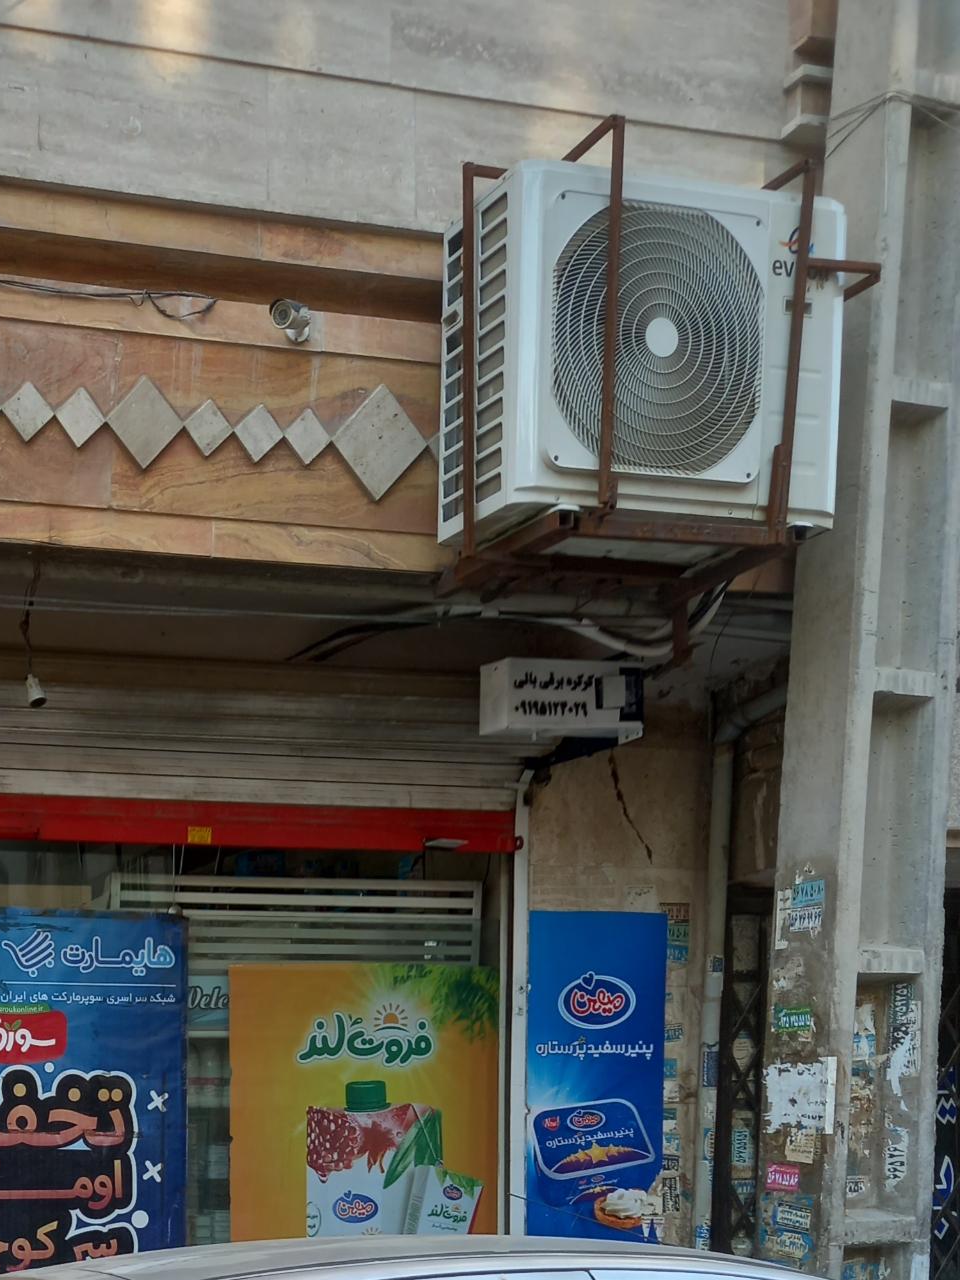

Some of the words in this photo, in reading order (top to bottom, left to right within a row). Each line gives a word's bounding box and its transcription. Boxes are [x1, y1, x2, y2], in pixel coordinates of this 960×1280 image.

[60, 935, 176, 977] هایمارت
[0, 989, 26, 1004] ایران
[29, 990, 48, 1004] های
[51, 991, 104, 1006] سوپرمارکت
[149, 993, 177, 1006] شبکه
[569, 987, 625, 1018] میهن
[587, 1040, 625, 1058] سفید
[625, 1040, 654, 1061] پنیر
